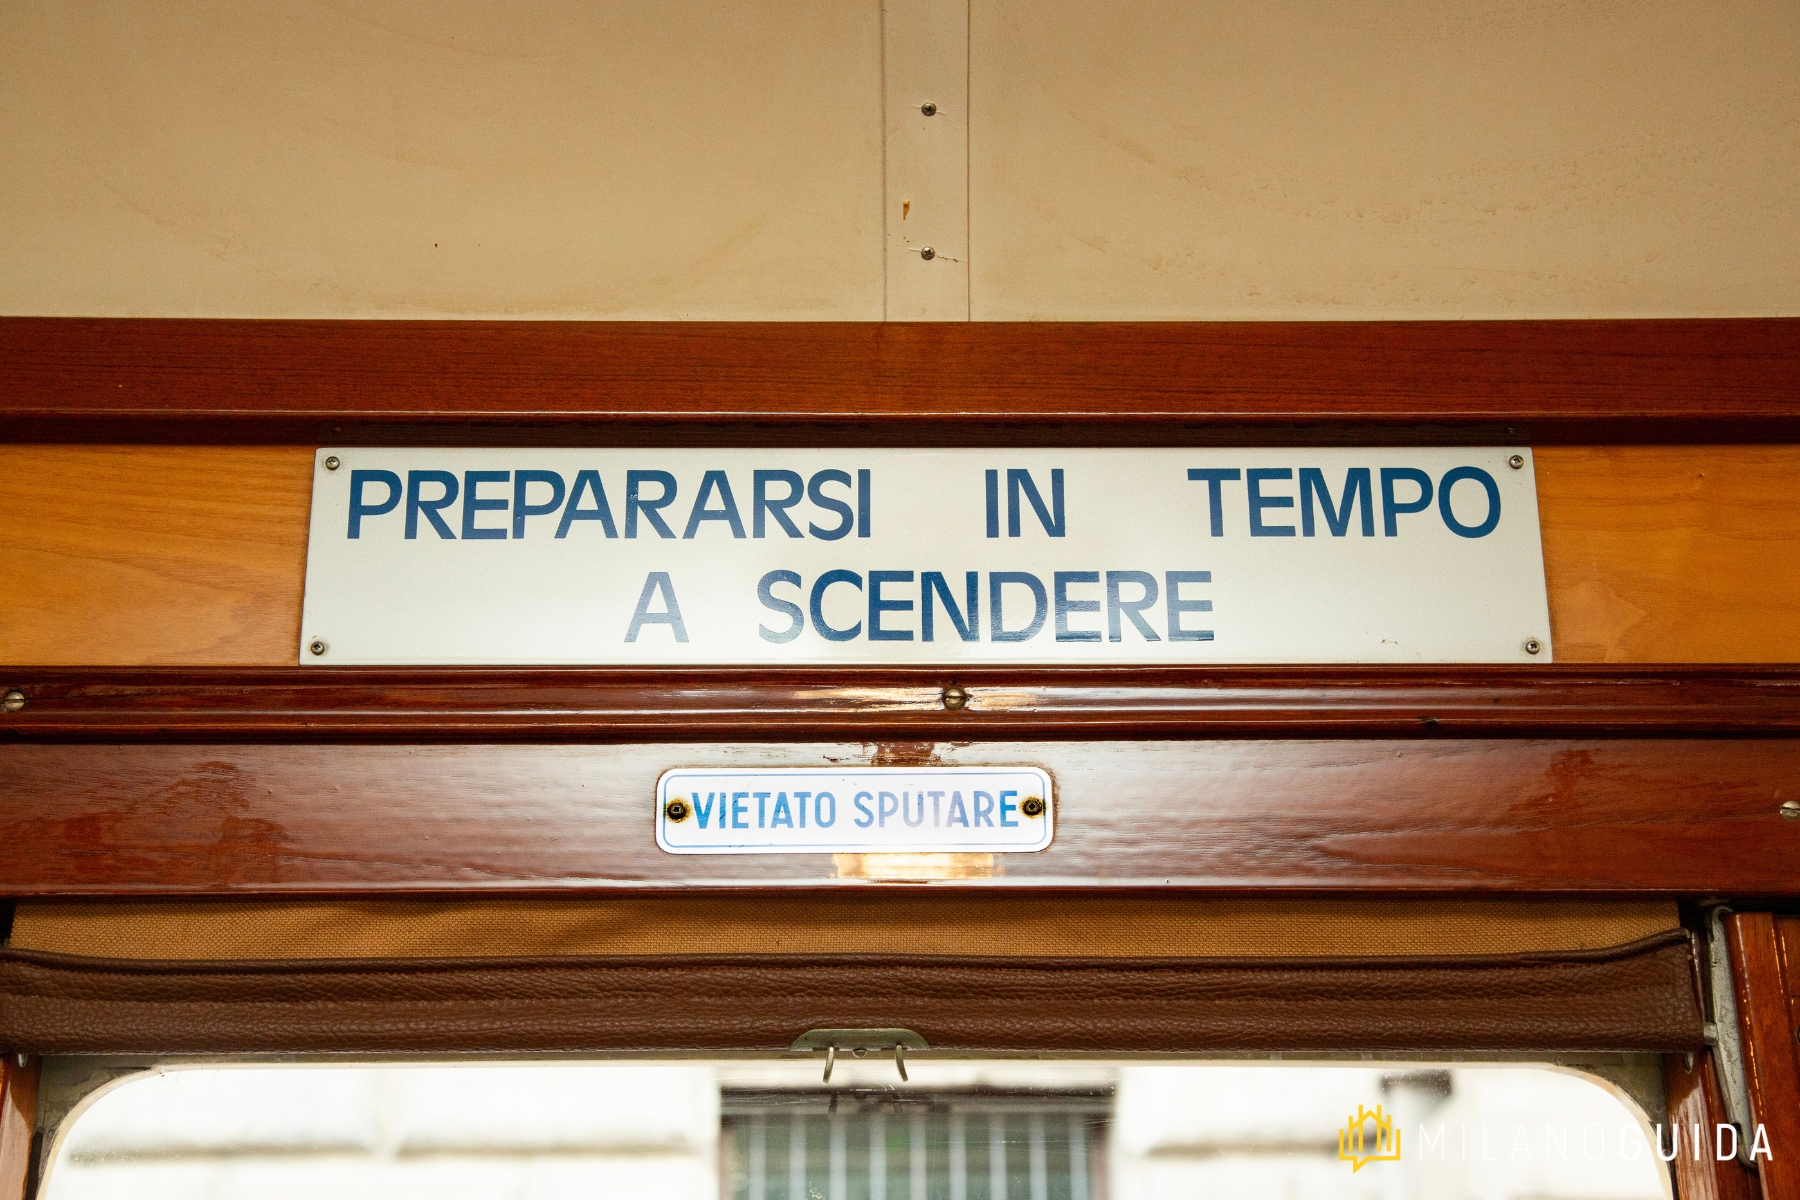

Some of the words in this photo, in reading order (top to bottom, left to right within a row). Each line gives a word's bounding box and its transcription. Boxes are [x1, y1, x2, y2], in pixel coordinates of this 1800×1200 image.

[346, 468, 872, 541] PREPARARSI
[984, 467, 1067, 539] IN
[1187, 465, 1502, 539] TEMPO
[623, 571, 690, 643] A
[756, 568, 1215, 644] SCENDERE
[691, 791, 837, 830] VIETATO
[853, 790, 1020, 829] SPUTARE
